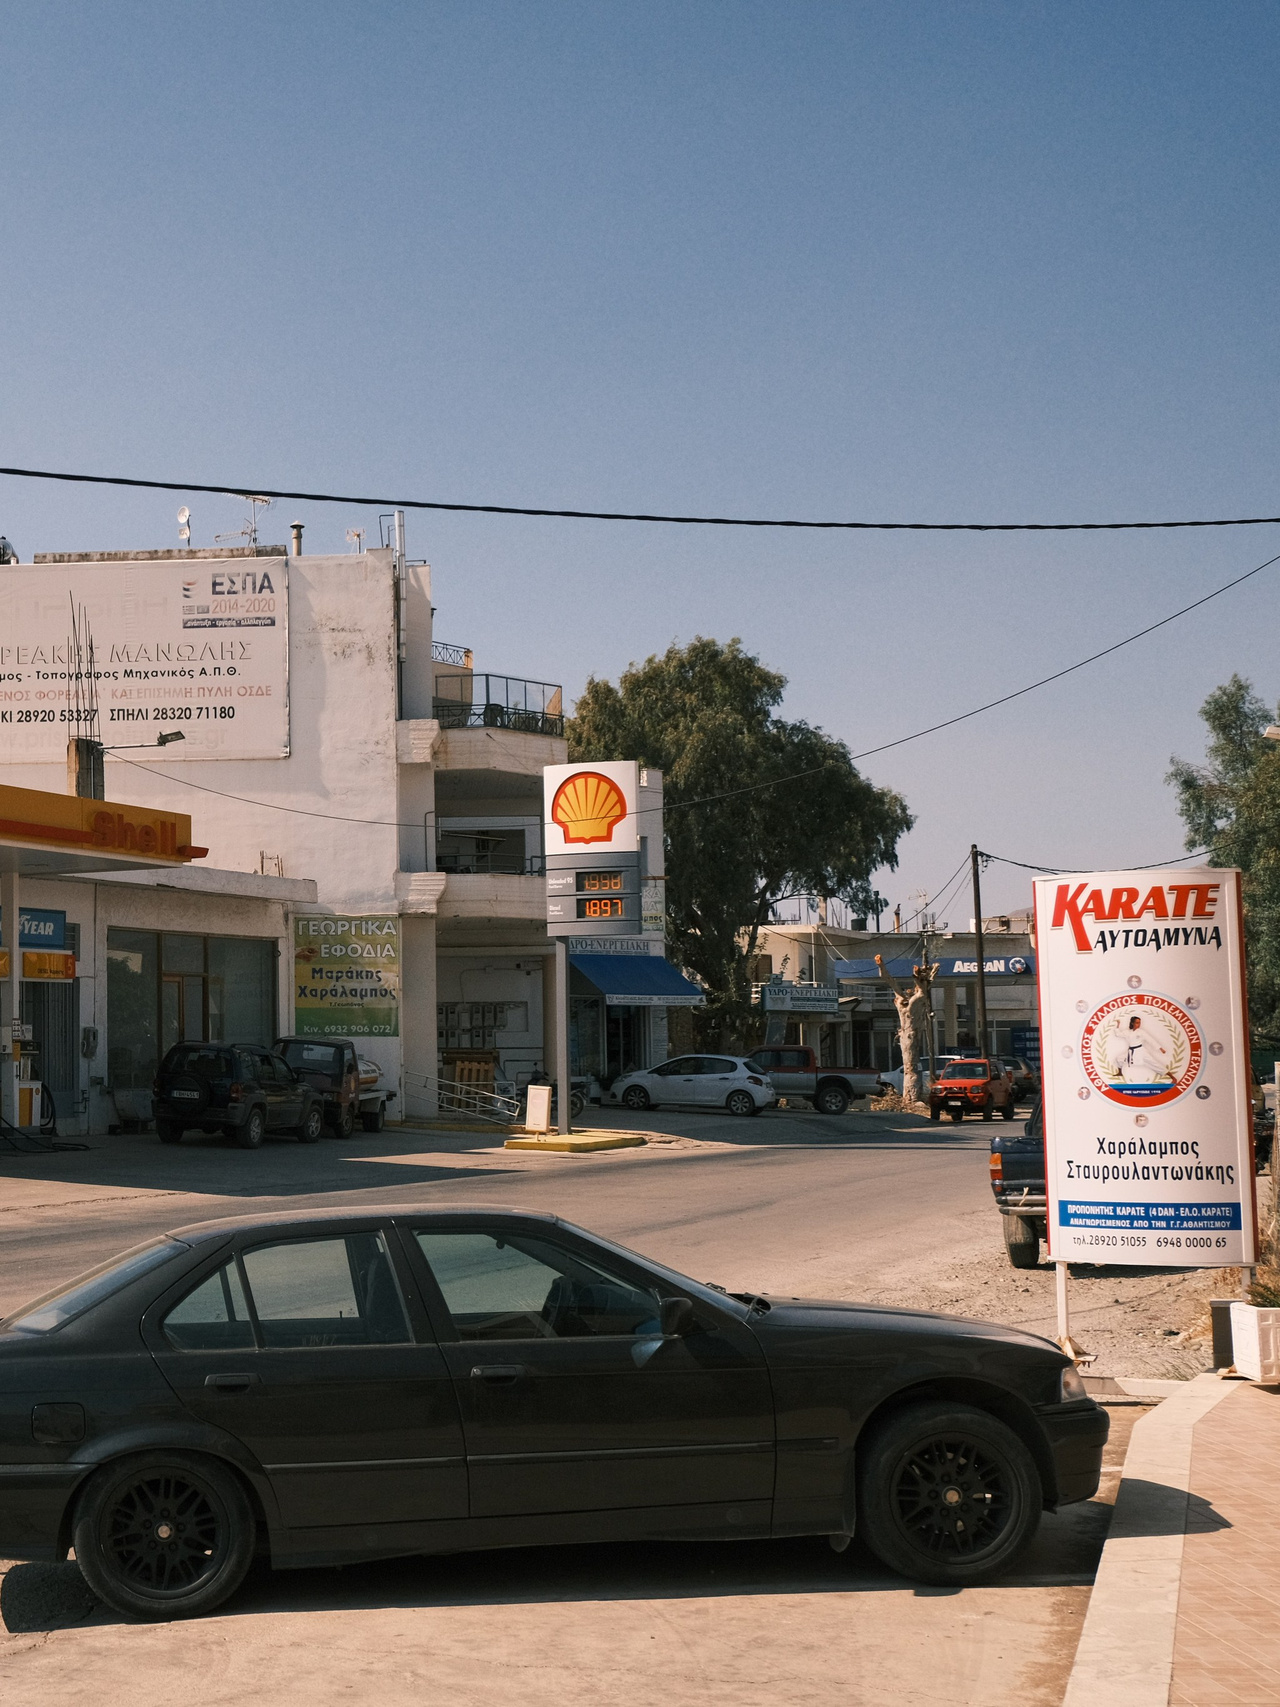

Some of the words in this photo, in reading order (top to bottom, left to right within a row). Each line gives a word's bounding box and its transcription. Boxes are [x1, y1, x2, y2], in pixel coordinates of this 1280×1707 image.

[212, 572, 274, 595] ΕΣΠΑ
[212, 598, 275, 614] 2014-2020
[110, 642, 252, 662] ΜΑΝΩΛΗΣ
[36, 669, 118, 681] Τοπογράφος
[124, 667, 194, 679] Μηχανικός
[199, 667, 240, 676] Α.Π.Θ.
[137, 687, 193, 698] ΕΠΙΣΗΜΗ
[198, 686, 232, 697] ΠΥΛΗ
[236, 685, 272, 697] ΟΣΔΕ
[17, 710, 55, 722] 28920
[60, 709, 98, 722] 53327
[110, 708, 148, 720] ΣΠΗΛΙ
[153, 707, 191, 720] 28320
[196, 706, 235, 719] 71180
[94, 811, 176, 855] Shell
[1052, 883, 1220, 952] KARATE
[298, 921, 397, 935] ΓΕΩΡΓΙΚΑ
[1094, 926, 1222, 953] ΑΥΤΟΑΜΥΝΑ
[321, 944, 396, 958] ΕΦΟΔΙΑ
[312, 967, 382, 982] Μαράκης
[298, 985, 396, 1000] Χαράλαμπος
[1089, 996, 1138, 1030] ΣΥΛΛΟΓΟΣ
[1144, 996, 1200, 1044] ΠΟΛΕΜΙΚΩΝ
[325, 1025, 347, 1033] 6932
[351, 1025, 369, 1033] 906
[373, 1025, 391, 1033] 072
[1082, 1034, 1109, 1092] ΑΘΛΗΤΙΚΟΣ
[1176, 1049, 1201, 1092] ΤΕΧΝΩΝ
[1097, 1137, 1199, 1158] Χαράλαμπος
[1067, 1160, 1234, 1184] Σταυρουλαντωνάκης
[1068, 1205, 1114, 1215] ΠΡΟΠΟΝΗΤΗΣ
[1117, 1206, 1145, 1216] ΚΑΡΑΤΕ
[1149, 1207, 1156, 1217] (4
[1158, 1207, 1174, 1216] DAN
[1202, 1207, 1233, 1217] ΚΑΡΑΤΕ)
[1070, 1218, 1131, 1227] ΑΝΑΓΝΩΡΙΣΜΕΝΟΣ
[1133, 1220, 1148, 1228] ΑΠΟ
[1151, 1220, 1167, 1228] ΤΗΝ
[1170, 1220, 1231, 1228] Γ.Γ.ΑΘΛΗΤΙΣΜΟΥ
[1073, 1235, 1117, 1246] τηλ.28920
[1120, 1236, 1147, 1247] 51055
[1157, 1237, 1182, 1247] 6948
[1185, 1238, 1212, 1248] 0000
[1215, 1238, 1226, 1248] 65
